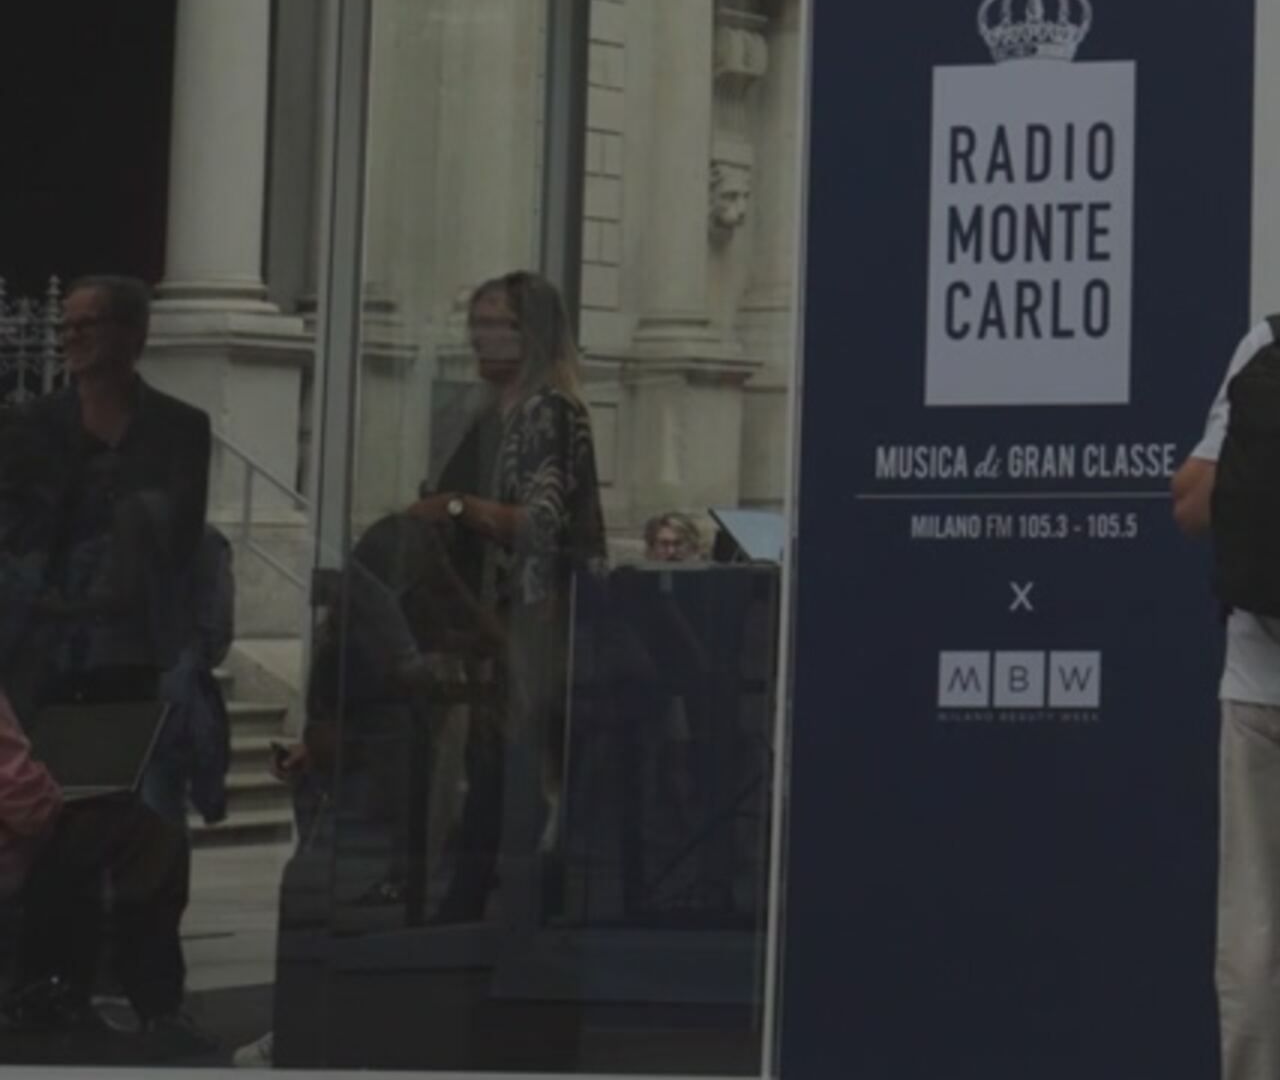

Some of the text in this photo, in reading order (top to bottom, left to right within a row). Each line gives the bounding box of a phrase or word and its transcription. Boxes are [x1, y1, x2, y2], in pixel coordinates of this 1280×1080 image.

[948, 121, 1115, 185] RADIO
[947, 201, 1112, 265] MONTE
[944, 277, 1111, 341] CARLO
[875, 442, 1177, 480] MUSICA di GRAN CLASSE
[911, 513, 982, 540] MILANO
[985, 514, 1014, 539] FM
[1019, 513, 1069, 540] 105.3
[1087, 513, 1138, 540] 105.5
